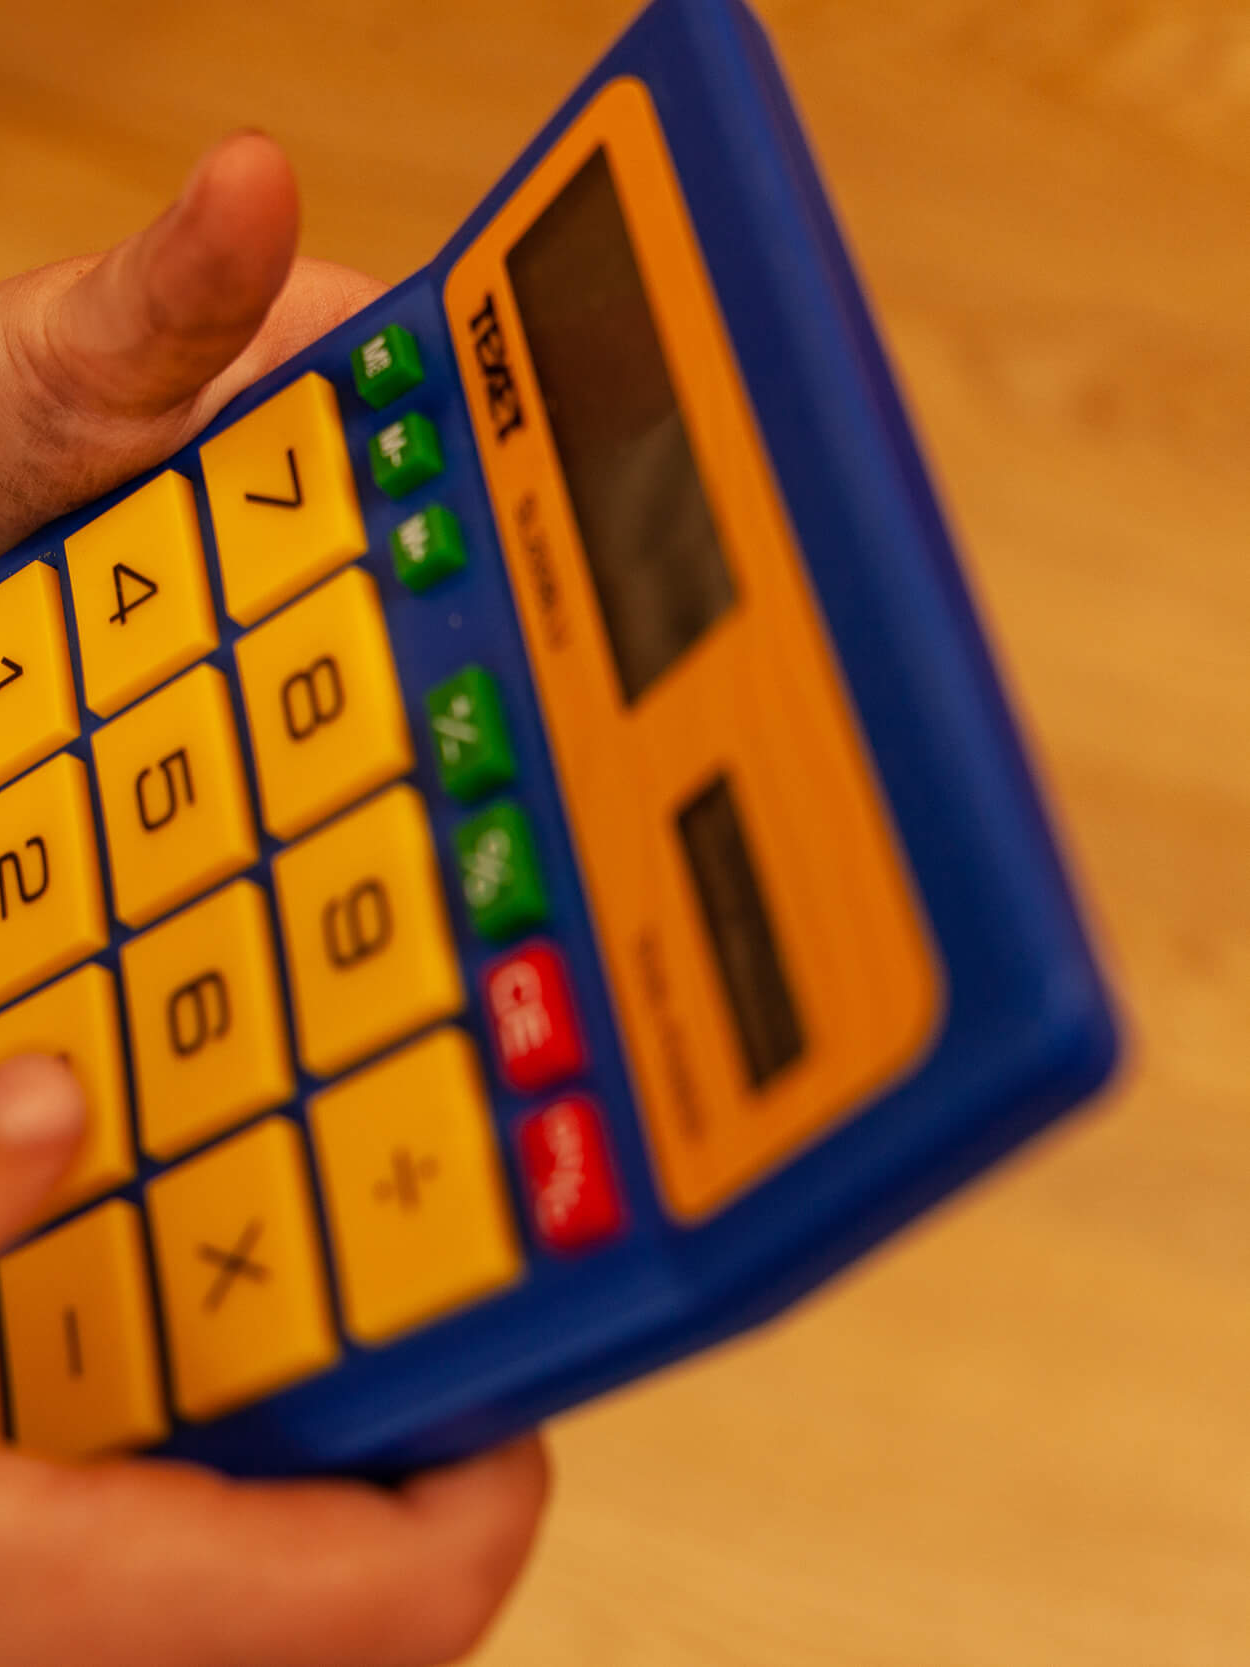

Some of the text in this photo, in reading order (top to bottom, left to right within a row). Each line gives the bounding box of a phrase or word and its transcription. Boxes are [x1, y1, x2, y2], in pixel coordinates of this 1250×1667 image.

[243, 447, 303, 510] 7
[108, 561, 159, 626] 4
[280, 653, 347, 743] 8
[135, 747, 196, 834] 5
[321, 876, 395, 972] 9
[166, 967, 232, 1060] 6
